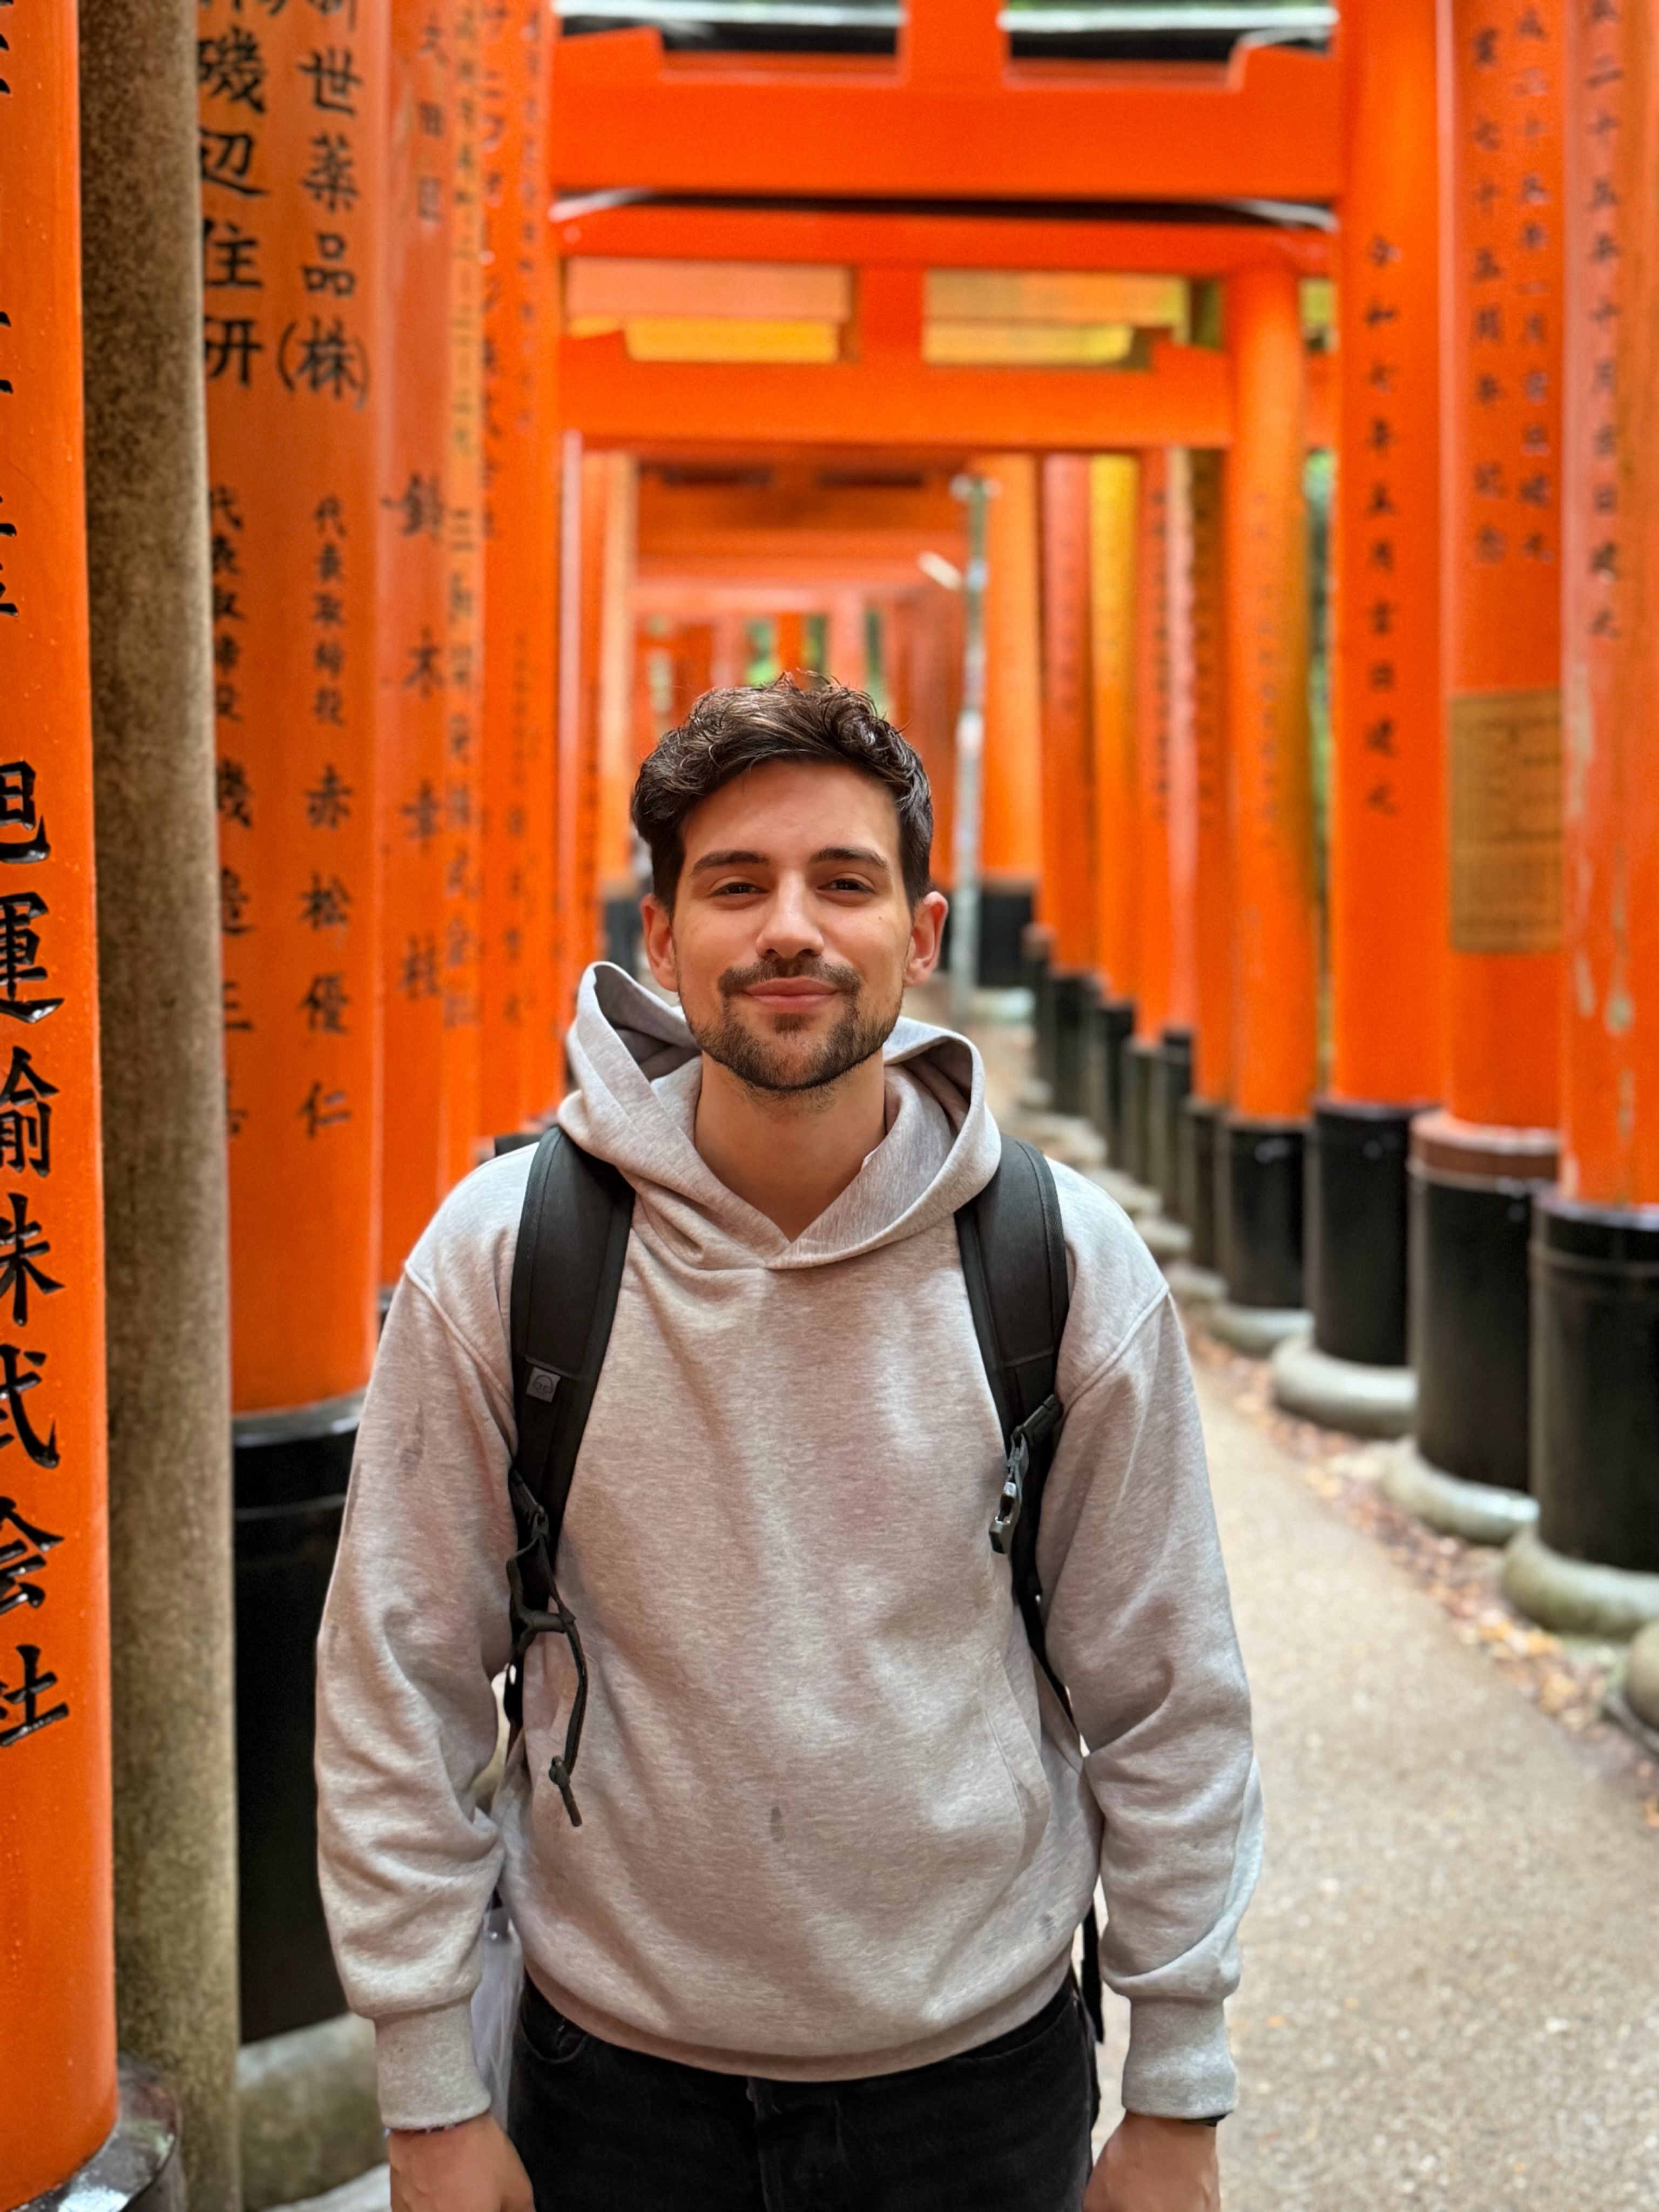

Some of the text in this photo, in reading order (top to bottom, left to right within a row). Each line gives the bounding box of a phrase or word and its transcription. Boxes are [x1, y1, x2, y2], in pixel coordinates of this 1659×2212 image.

[277, 0, 374, 410] 世薬品(株)
[312, 495, 348, 728] 代表取締役
